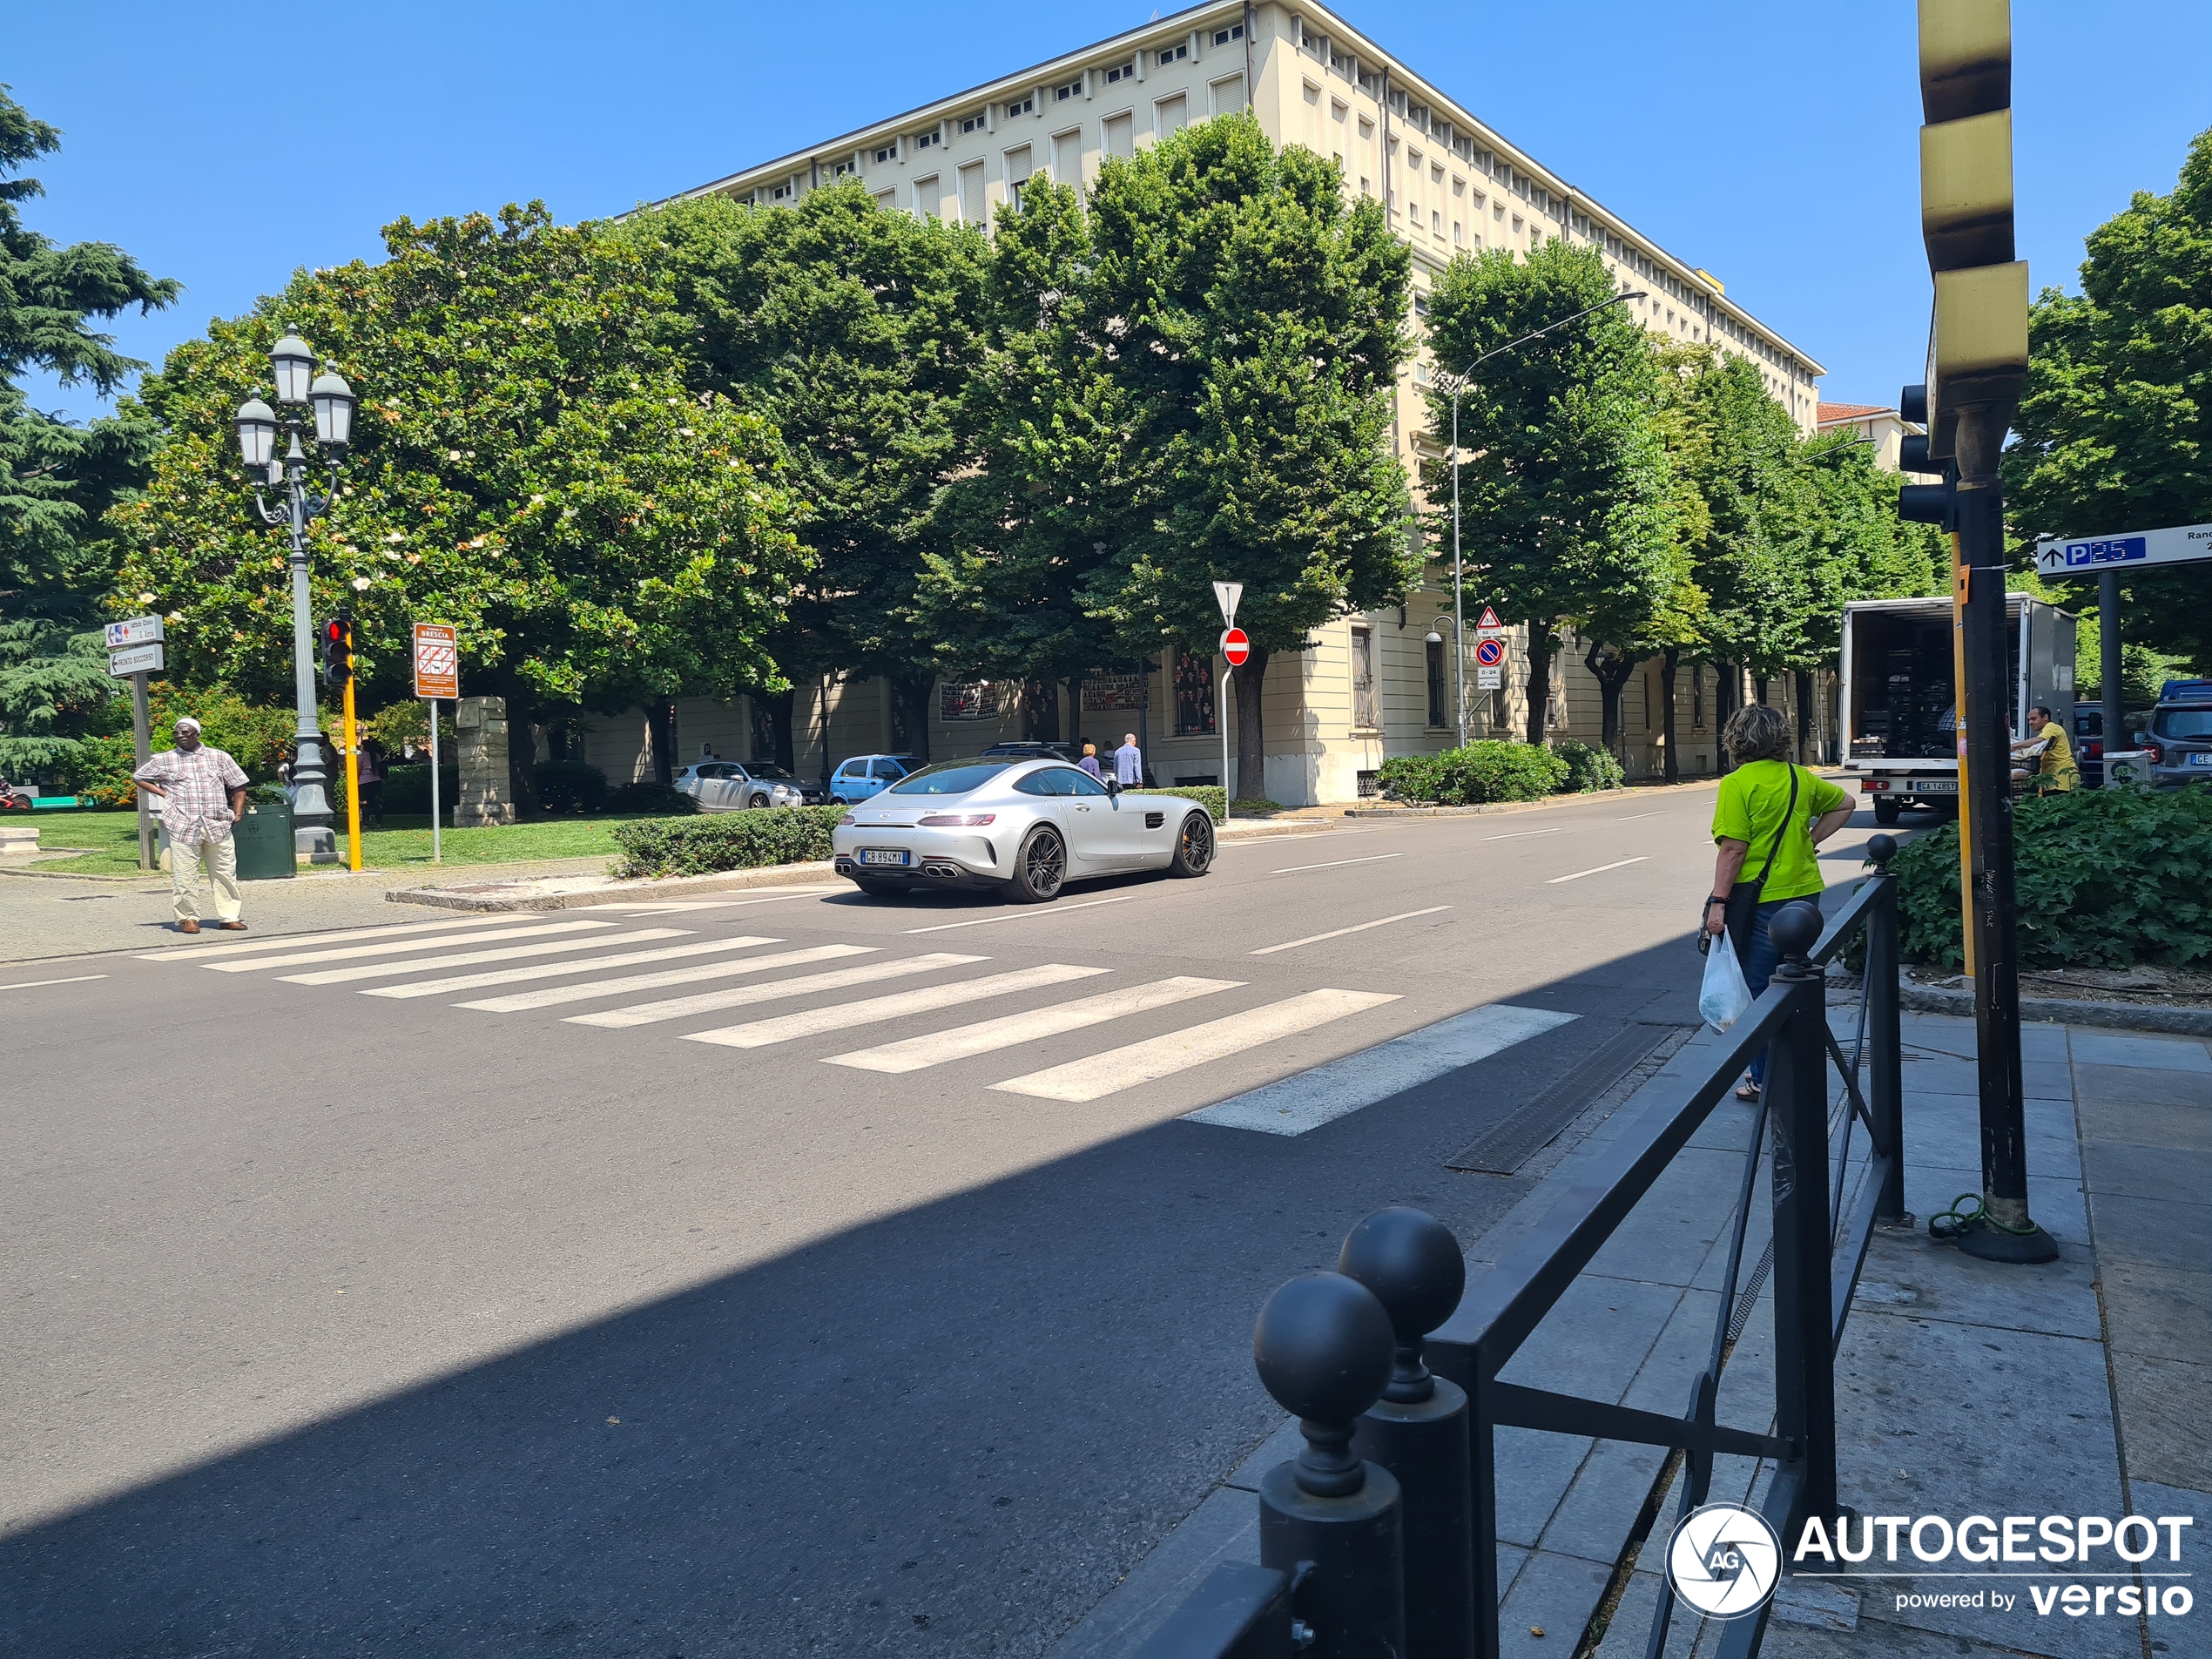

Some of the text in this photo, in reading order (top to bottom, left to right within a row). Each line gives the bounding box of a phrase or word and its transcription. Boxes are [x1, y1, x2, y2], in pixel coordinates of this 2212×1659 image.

[2071, 540, 2126, 563] P 25
[118, 653, 154, 667] PRONTO SOCCORSO
